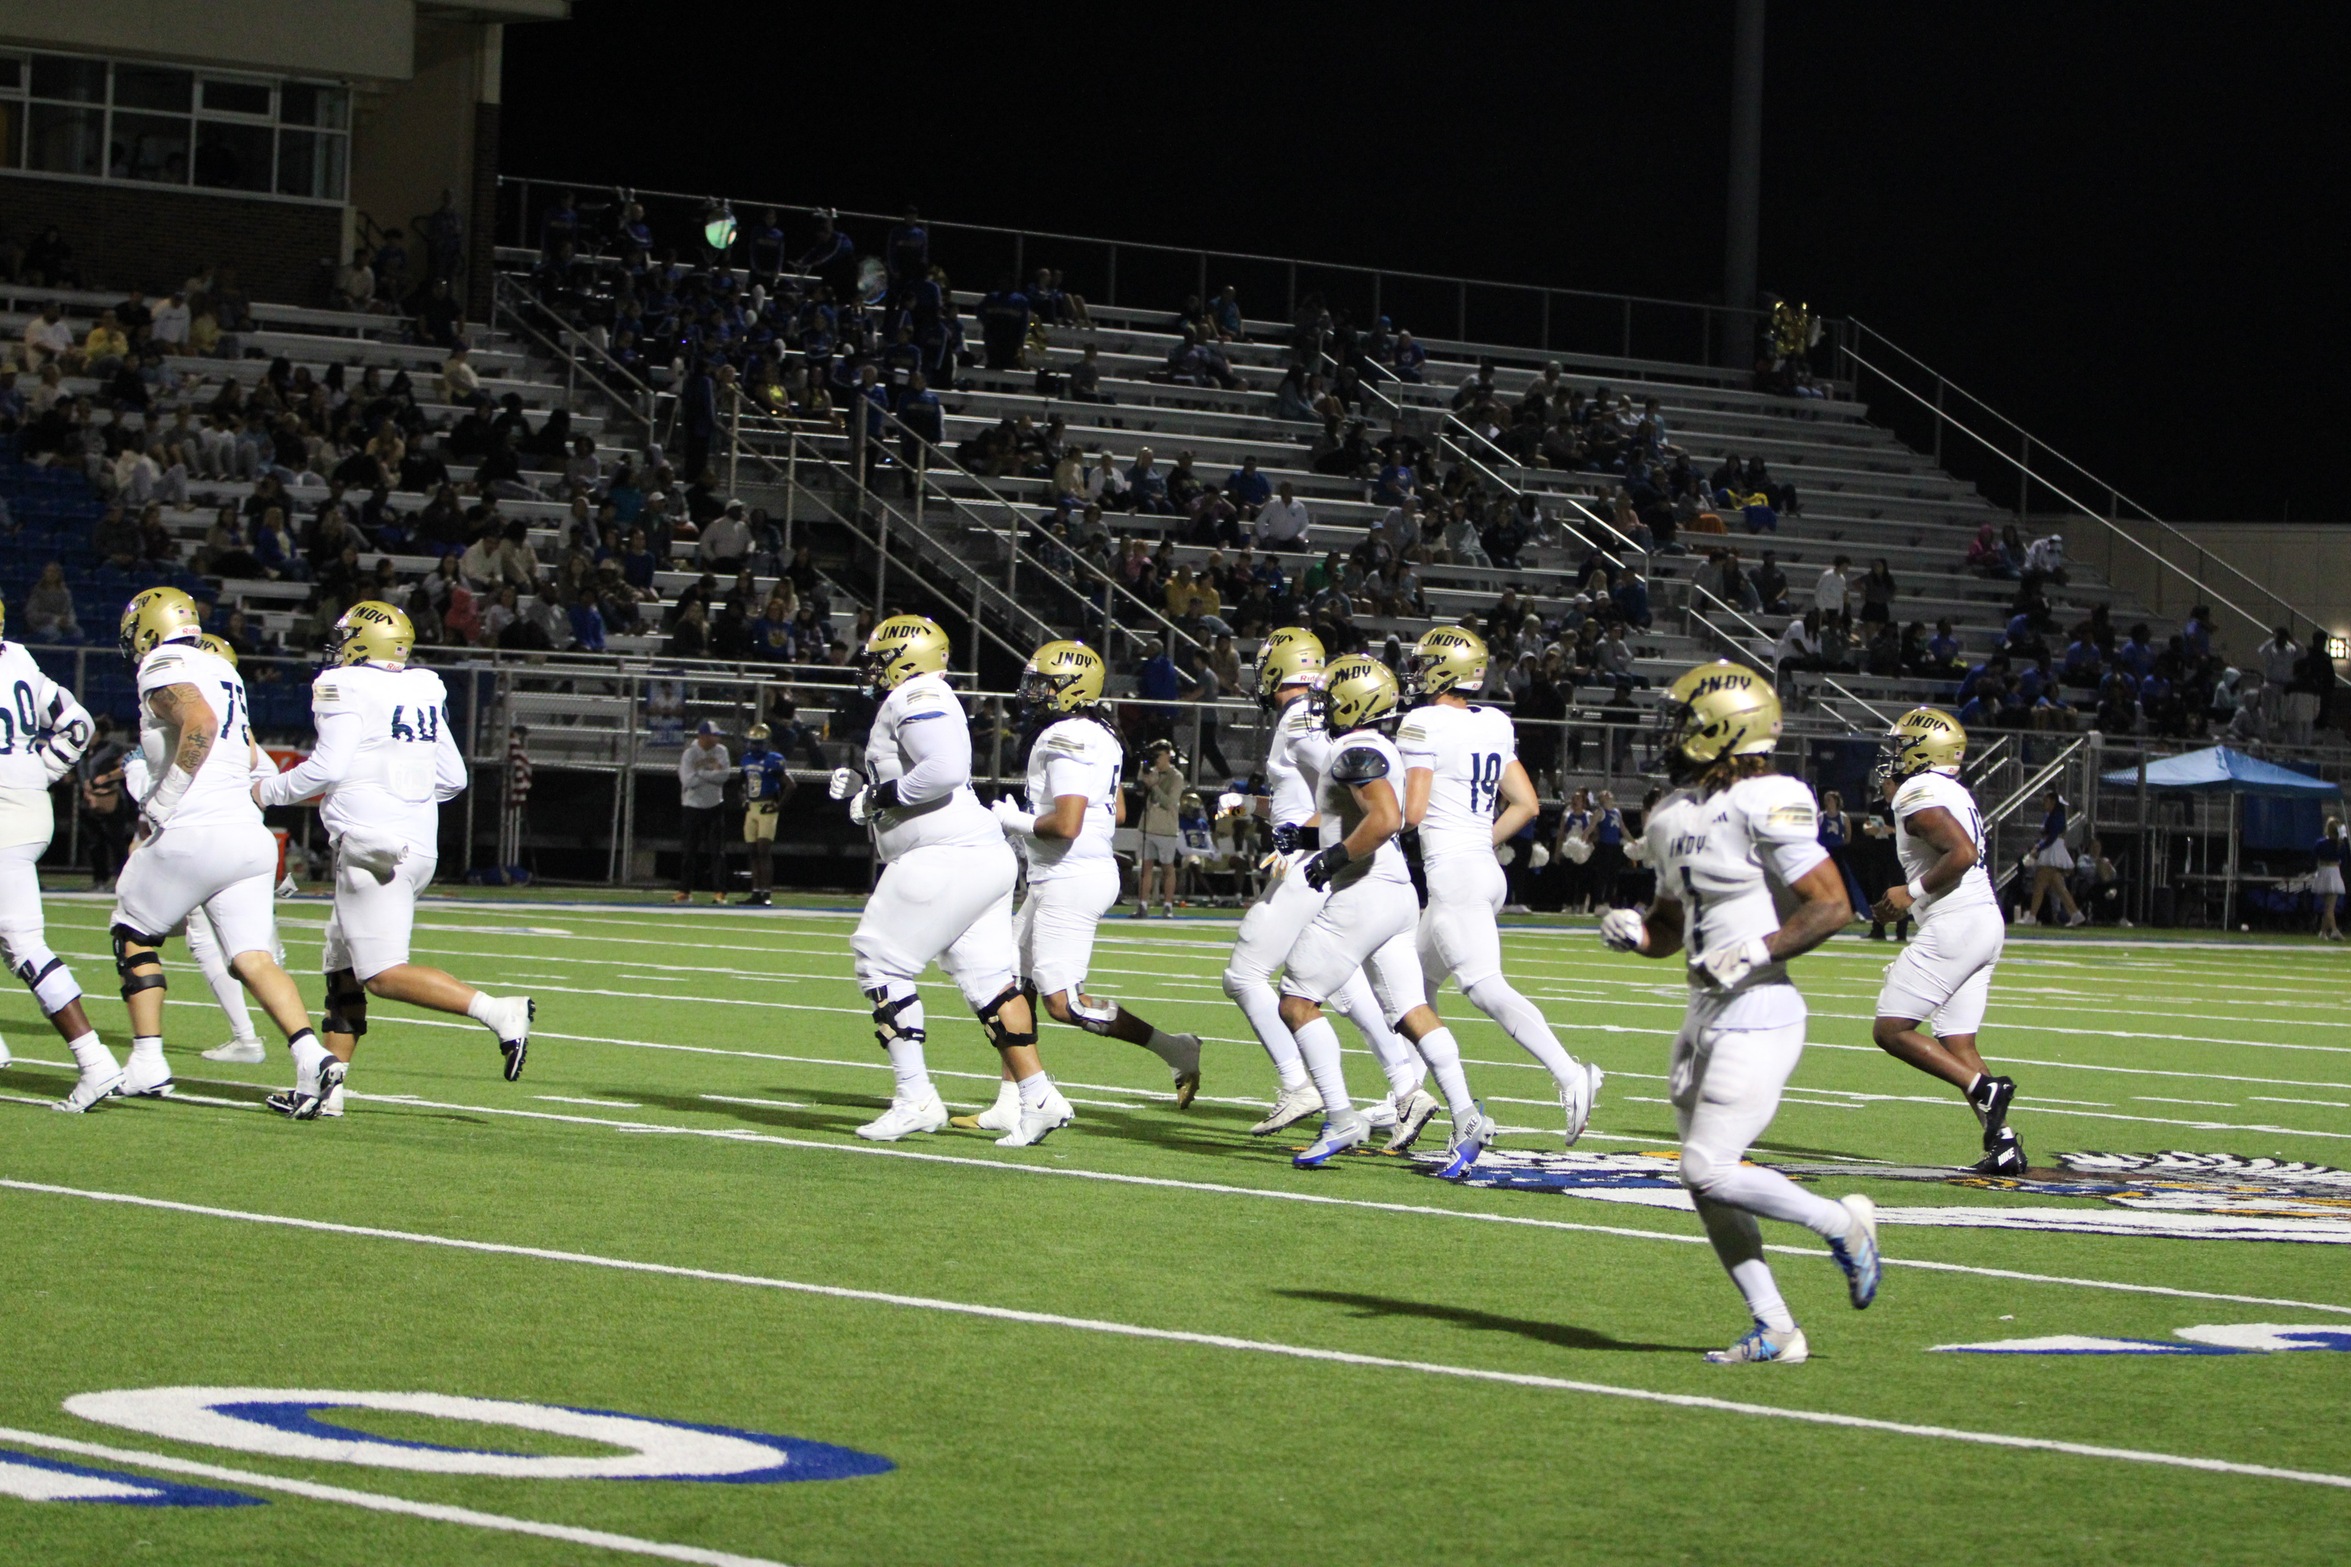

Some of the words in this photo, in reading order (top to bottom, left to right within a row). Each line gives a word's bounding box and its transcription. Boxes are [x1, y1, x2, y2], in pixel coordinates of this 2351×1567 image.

[882, 625, 921, 640] INDY
[1428, 633, 1464, 648] INDY
[1056, 651, 1093, 669] INDY
[1335, 665, 1371, 685] INDY
[1700, 675, 1751, 697] INDY
[1906, 714, 1946, 731] INDY
[1470, 752, 1502, 813] 19
[1670, 835, 1707, 858] INDY
[1464, 1116, 1479, 1140] NIKE
[1998, 1147, 2016, 1167] NIKE
